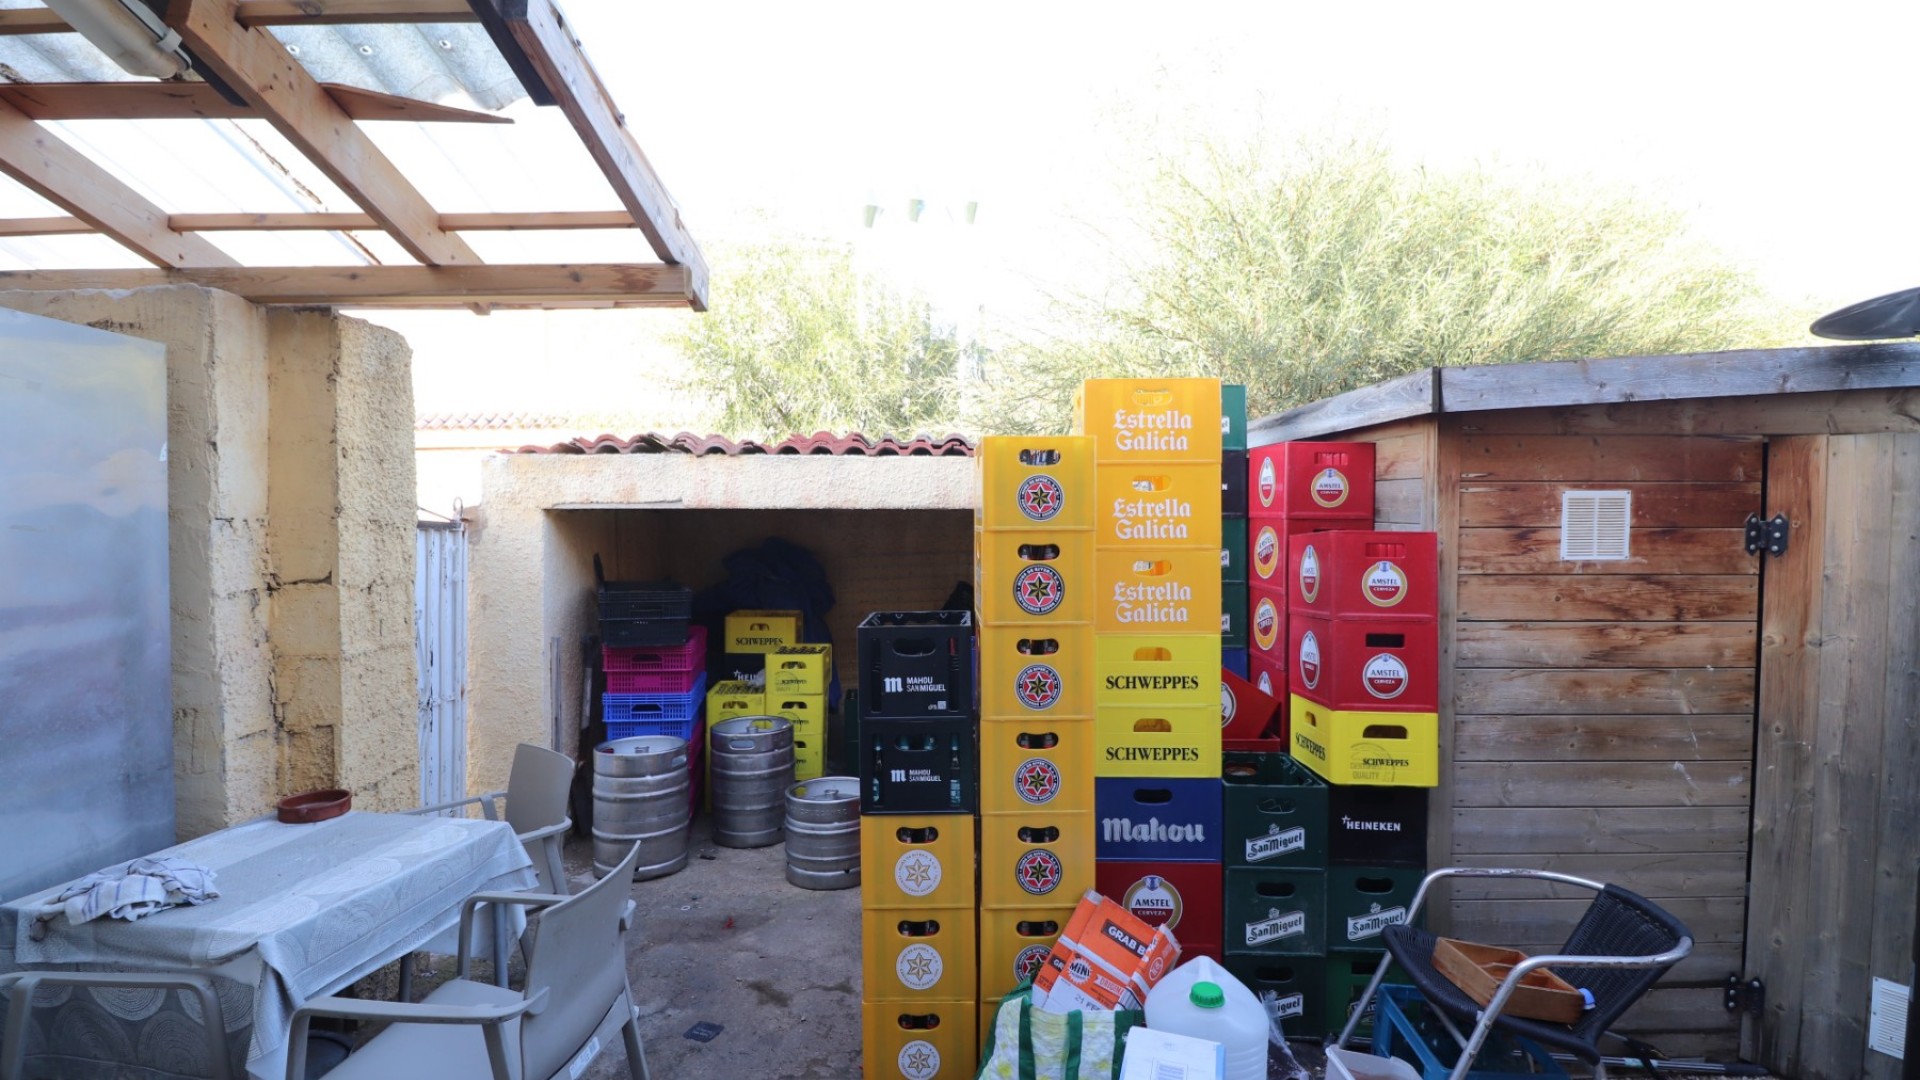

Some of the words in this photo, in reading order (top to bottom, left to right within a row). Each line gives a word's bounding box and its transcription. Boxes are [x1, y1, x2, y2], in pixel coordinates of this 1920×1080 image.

[1113, 409, 1192, 429] Estrella
[1115, 431, 1188, 451] Galicia
[1113, 498, 1192, 518] Estrella
[1115, 520, 1188, 540] Galicia
[1113, 582, 1192, 602] Estrella
[1115, 604, 1188, 623] Galicia
[736, 637, 783, 645] SCHWEPPES
[907, 676, 933, 684] MAHOU
[1106, 675, 1199, 690] SCHWEPPES
[1106, 747, 1199, 761] SCHWEPPES
[1296, 732, 1326, 761] SCHWEPPES
[1363, 757, 1409, 766] SCHWEPPES
[1102, 817, 1205, 842] Mahou
[1346, 821, 1401, 831] HEINEKEN
[1135, 899, 1170, 907] AMSTEL
[1108, 926, 1136, 948] GRAB
[1277, 997, 1301, 1014] iguel
